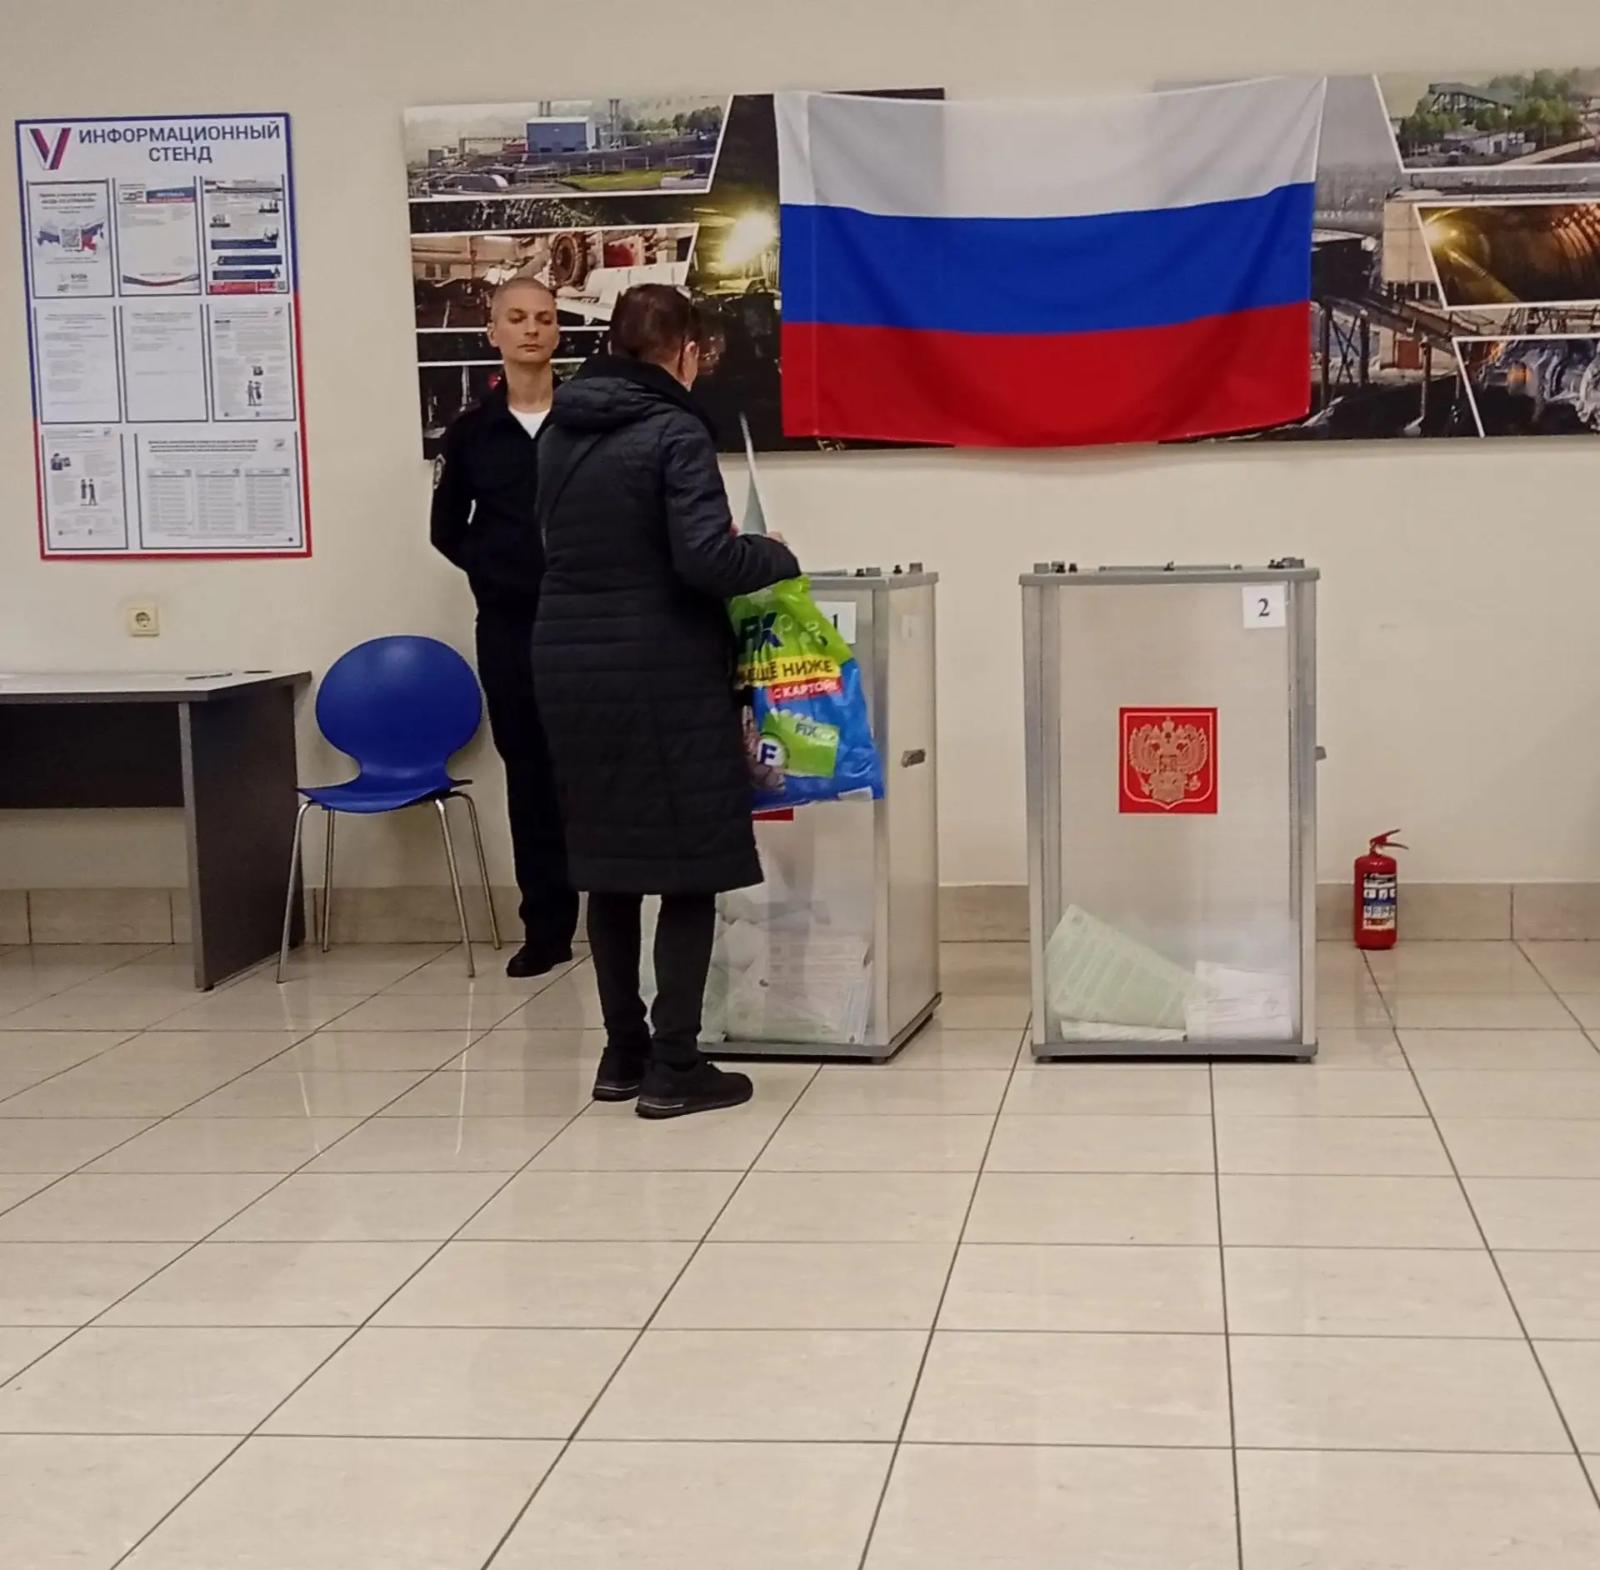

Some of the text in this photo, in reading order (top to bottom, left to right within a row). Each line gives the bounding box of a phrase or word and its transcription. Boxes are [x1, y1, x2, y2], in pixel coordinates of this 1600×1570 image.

[79, 121, 281, 144] ИНФОРМАЦИОННЫЙ
[148, 145, 213, 164] СТЕНД
[1258, 598, 1271, 617] 2
[782, 660, 834, 677] НИЖЕ
